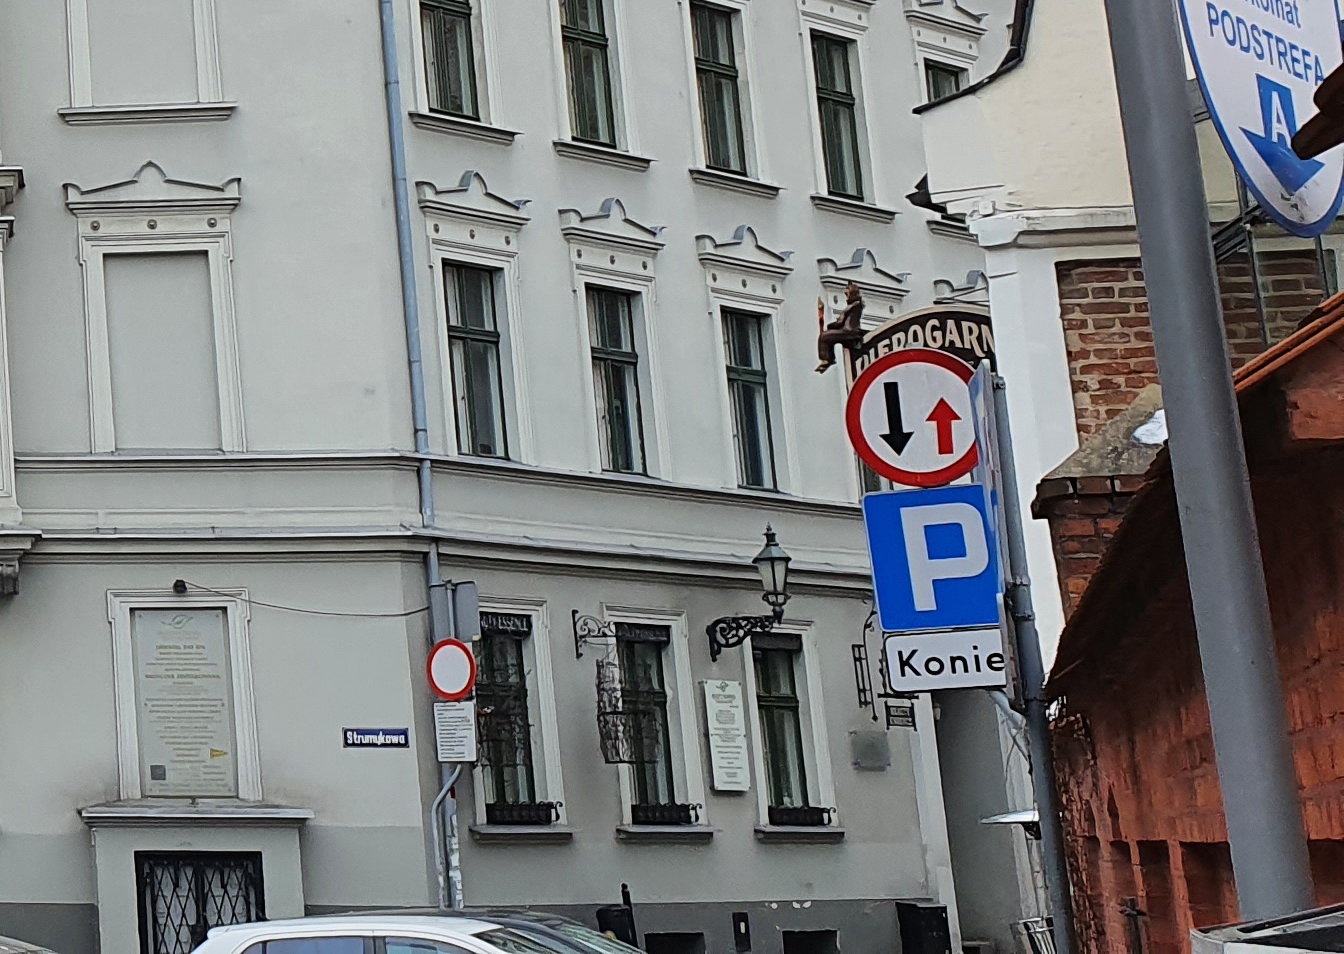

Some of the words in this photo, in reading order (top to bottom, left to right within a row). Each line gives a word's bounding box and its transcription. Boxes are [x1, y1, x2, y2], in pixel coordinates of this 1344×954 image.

[1205, 0, 1325, 87] PODSTREFA
[1271, 90, 1293, 147] A
[899, 502, 990, 612] P
[897, 645, 1006, 678] Konie
[346, 730, 406, 746] Strumykowa
